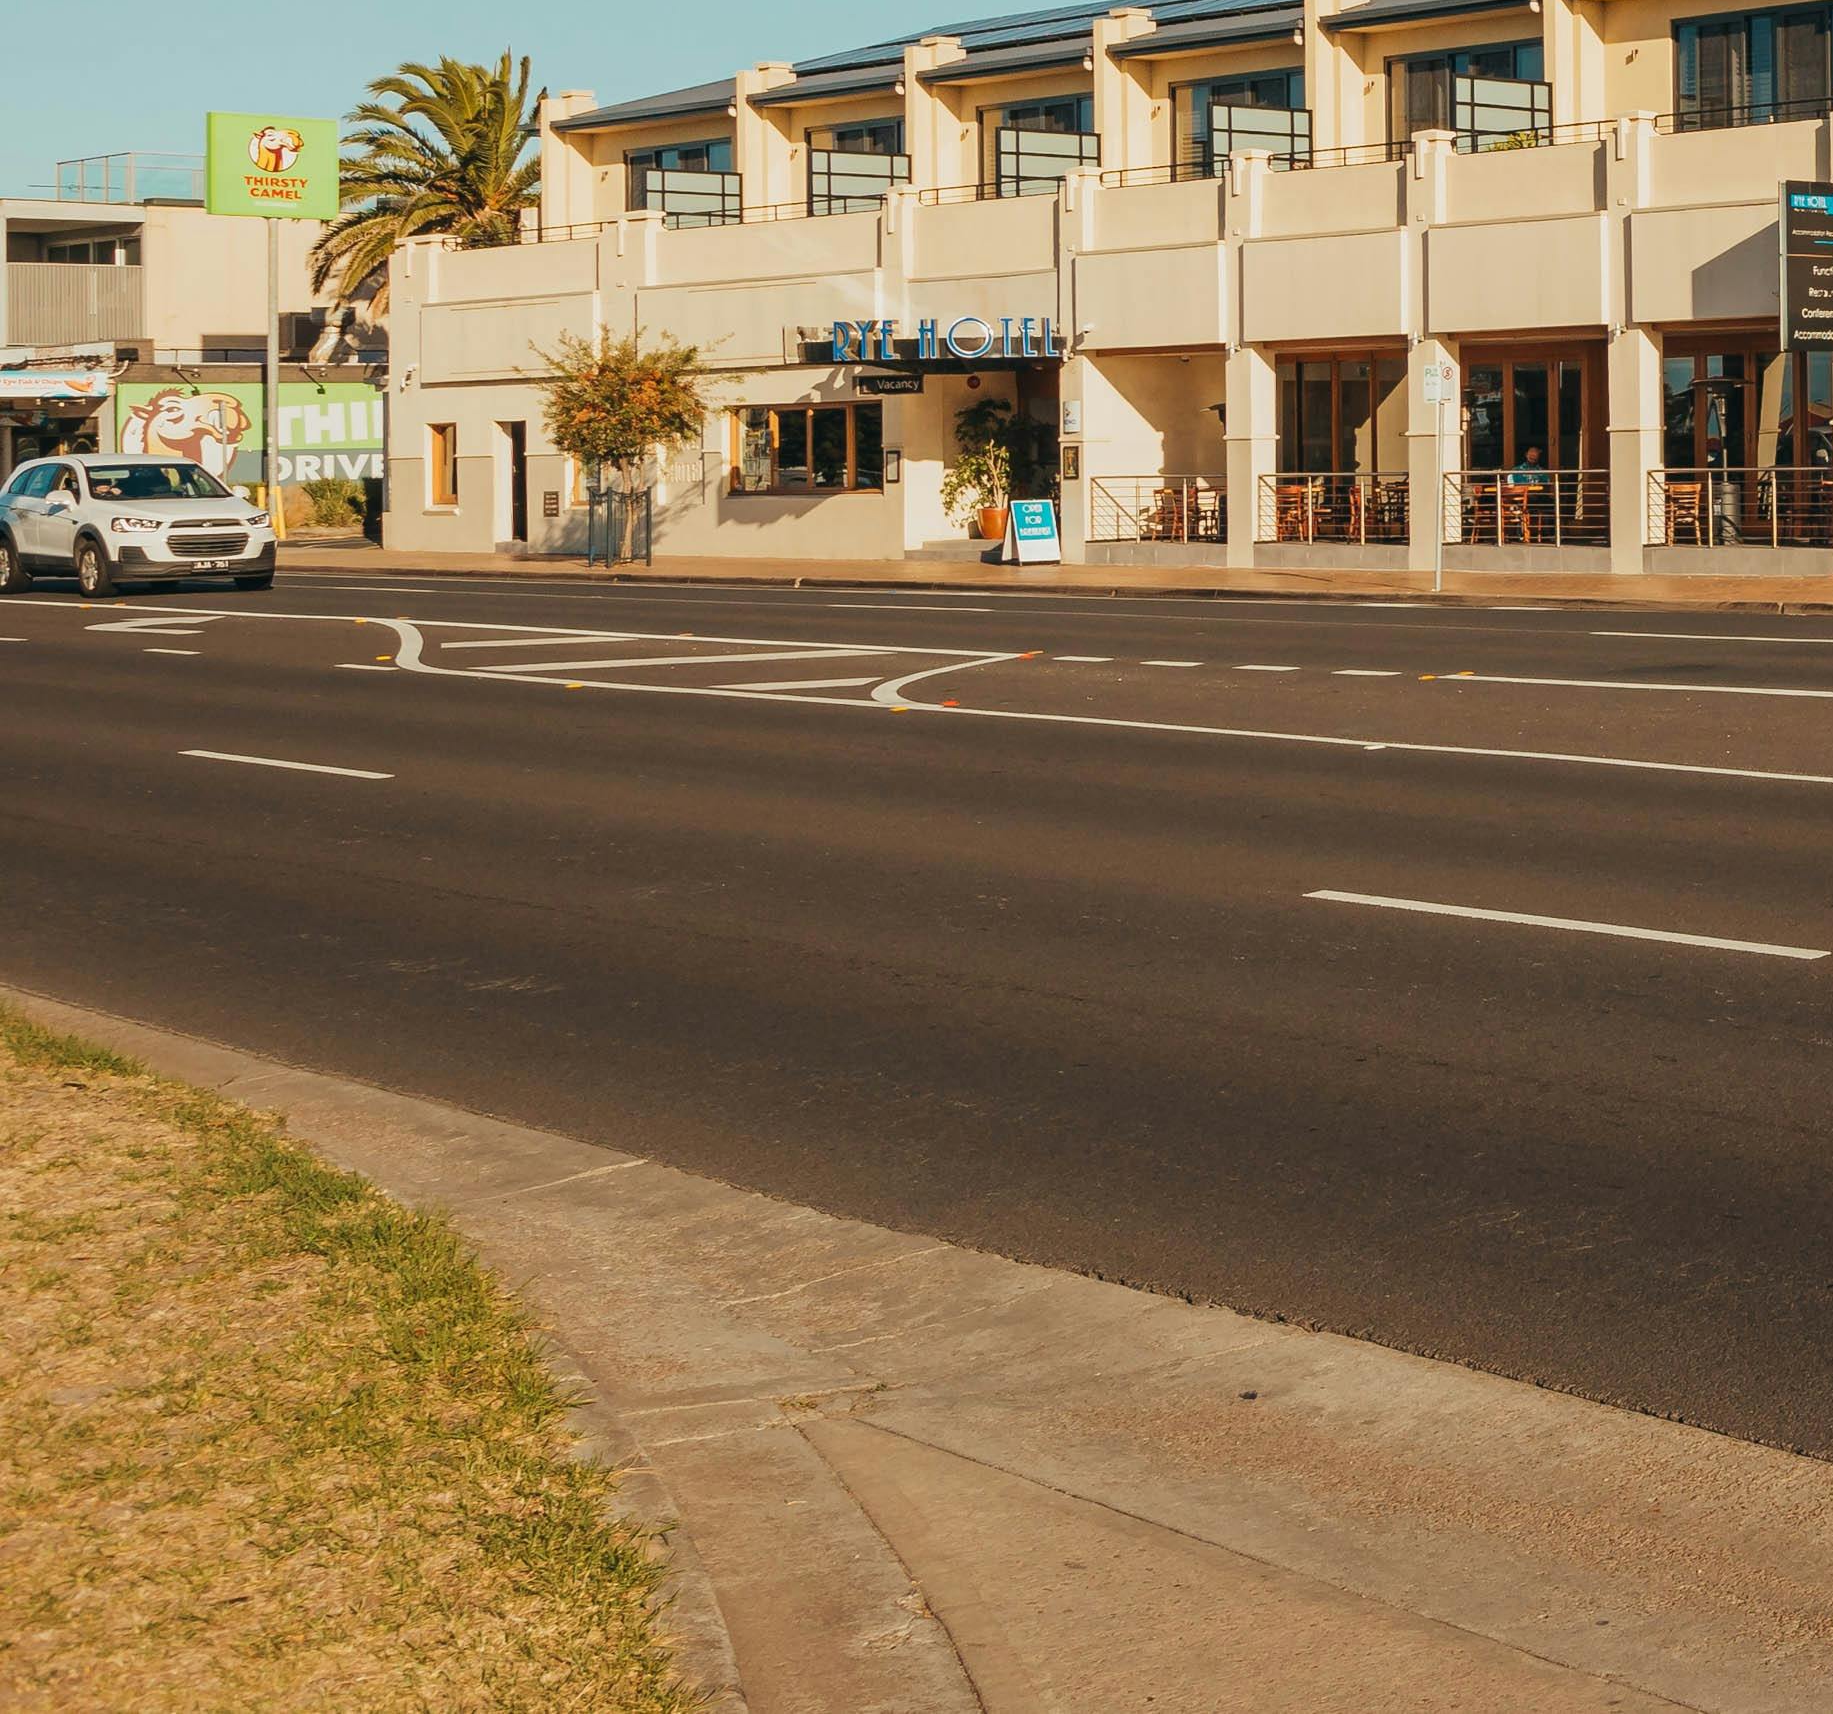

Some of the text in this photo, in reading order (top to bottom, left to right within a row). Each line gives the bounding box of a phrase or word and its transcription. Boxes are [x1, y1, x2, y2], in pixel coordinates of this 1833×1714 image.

[244, 176, 308, 188] THIRSTY
[250, 188, 302, 200] CAMEL
[832, 317, 1060, 362] RYE HOTEL
[876, 378, 920, 391] Vacancy
[277, 453, 385, 481] DRIVE
